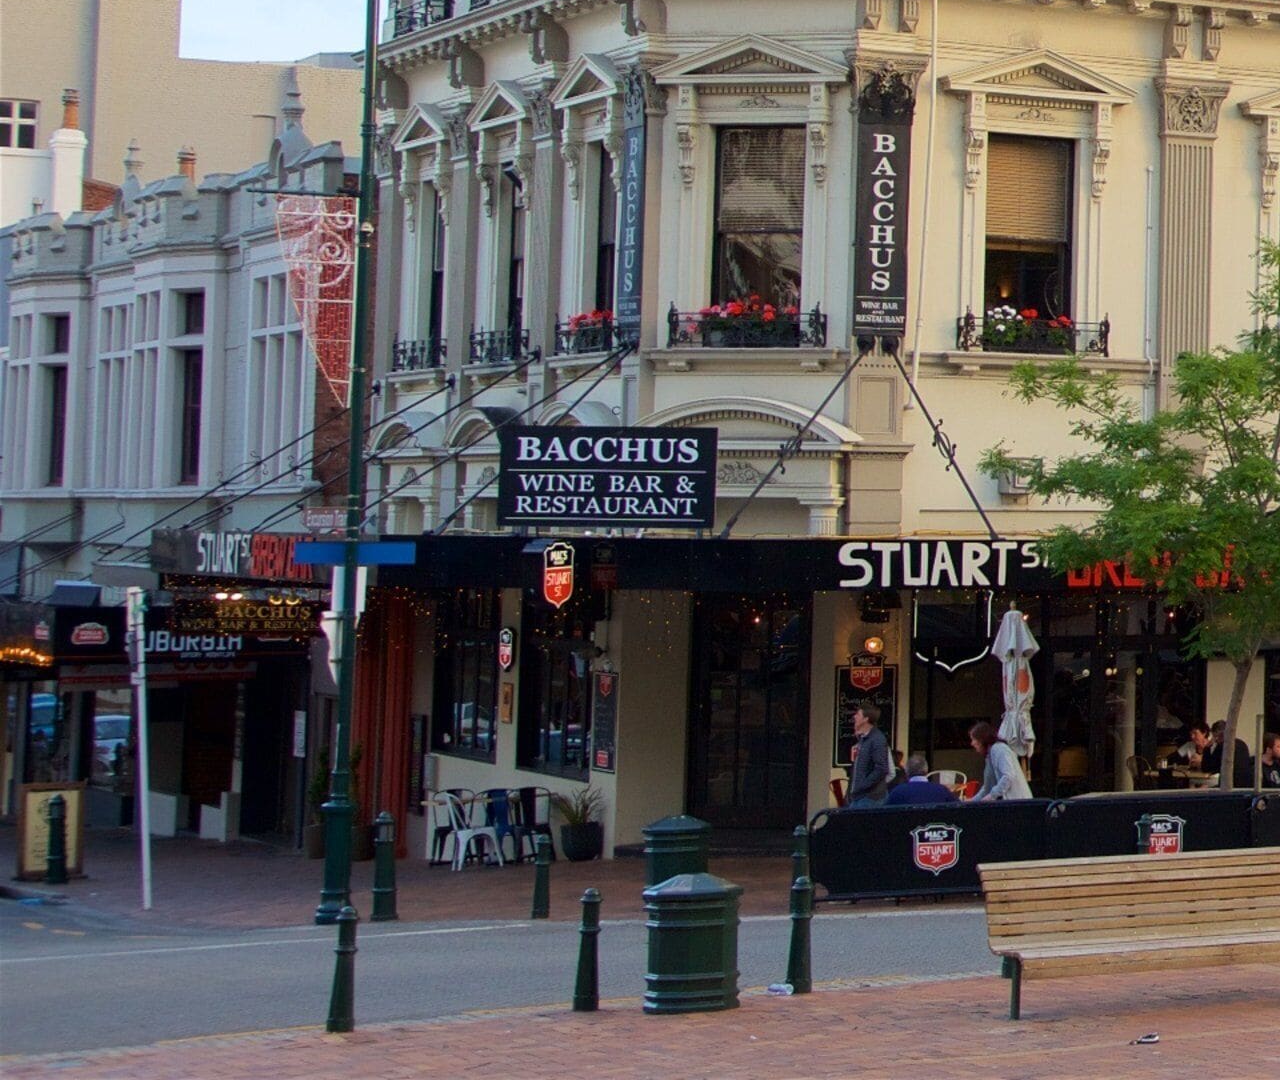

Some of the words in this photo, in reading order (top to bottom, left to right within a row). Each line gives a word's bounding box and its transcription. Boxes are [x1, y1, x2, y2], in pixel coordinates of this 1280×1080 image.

[623, 136, 639, 293] BACCHUS
[869, 133, 897, 292] BACCHUS
[856, 314, 905, 324] RESTAURANT
[516, 436, 699, 464] BACCHUS
[519, 474, 595, 492] WINE
[609, 475, 664, 493] BAR
[676, 476, 695, 494] &
[515, 495, 698, 516] RESTAURANT
[197, 532, 242, 575] STUART
[838, 541, 1018, 588] STUART
[547, 571, 571, 587] STUART
[218, 605, 311, 620] BACCHUS
[853, 668, 881, 678] STUART
[919, 844, 953, 855] STUART
[1150, 837, 1177, 847] TUART
